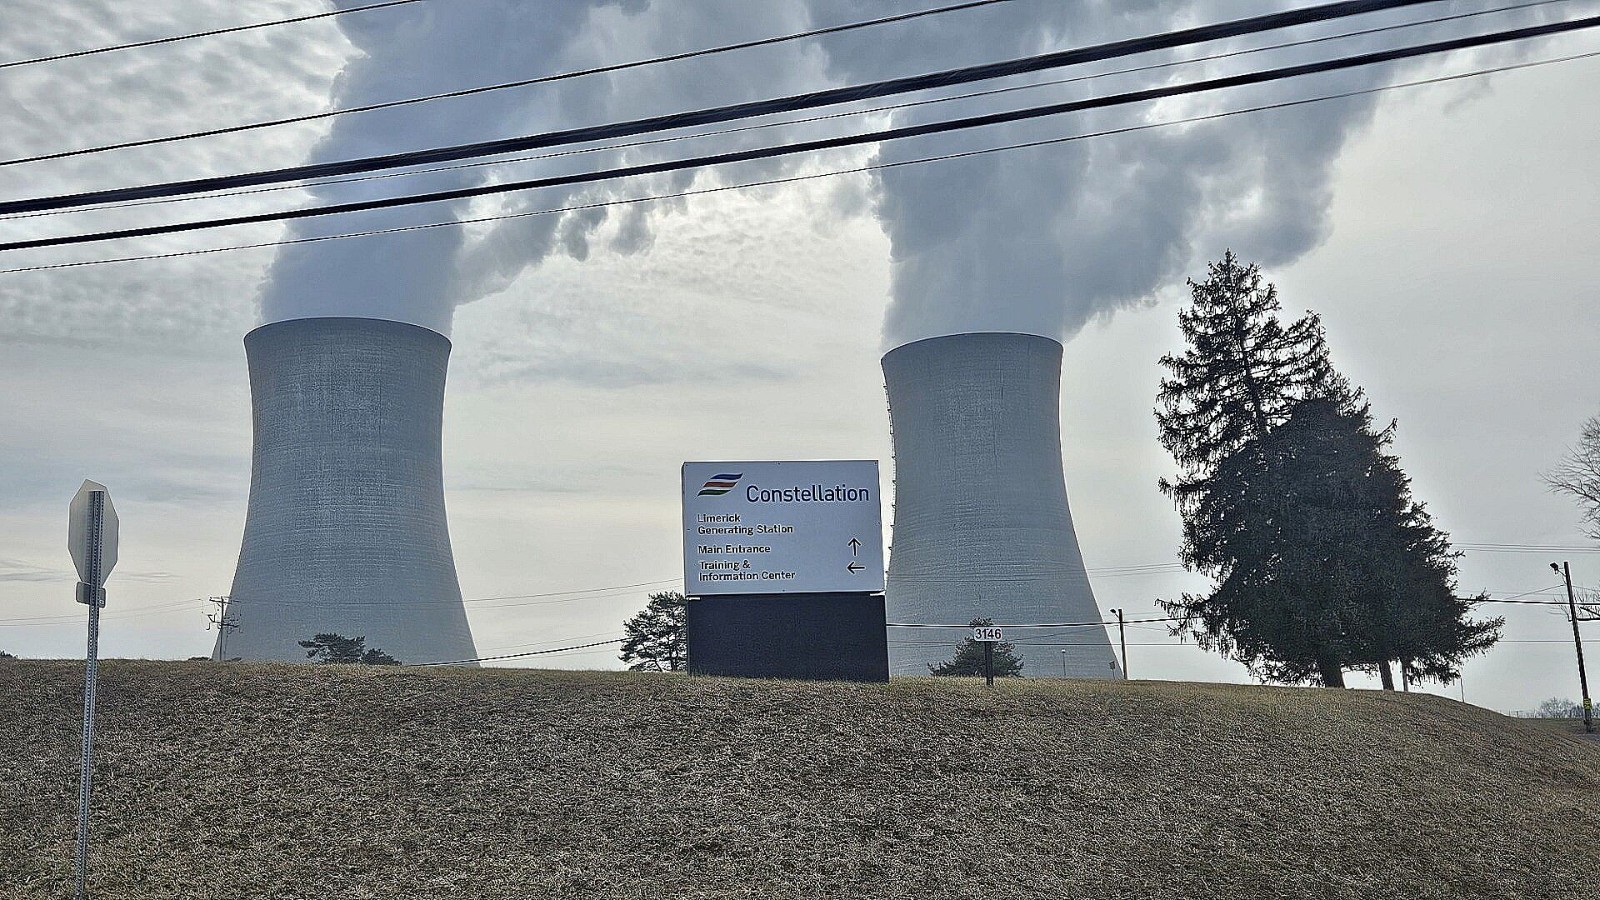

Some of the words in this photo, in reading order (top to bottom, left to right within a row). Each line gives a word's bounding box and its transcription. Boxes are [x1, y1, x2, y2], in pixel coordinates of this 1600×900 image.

[746, 484, 870, 503] Constellation
[697, 513, 741, 523] Limerick
[698, 525, 754, 536] Generating
[757, 524, 794, 534] Station
[698, 545, 723, 554] Main
[726, 545, 771, 554] Entrance
[699, 560, 740, 571] Training
[742, 560, 751, 569] &
[699, 571, 759, 582] Information
[762, 571, 796, 580] Center
[975, 628, 1002, 640] 3146
